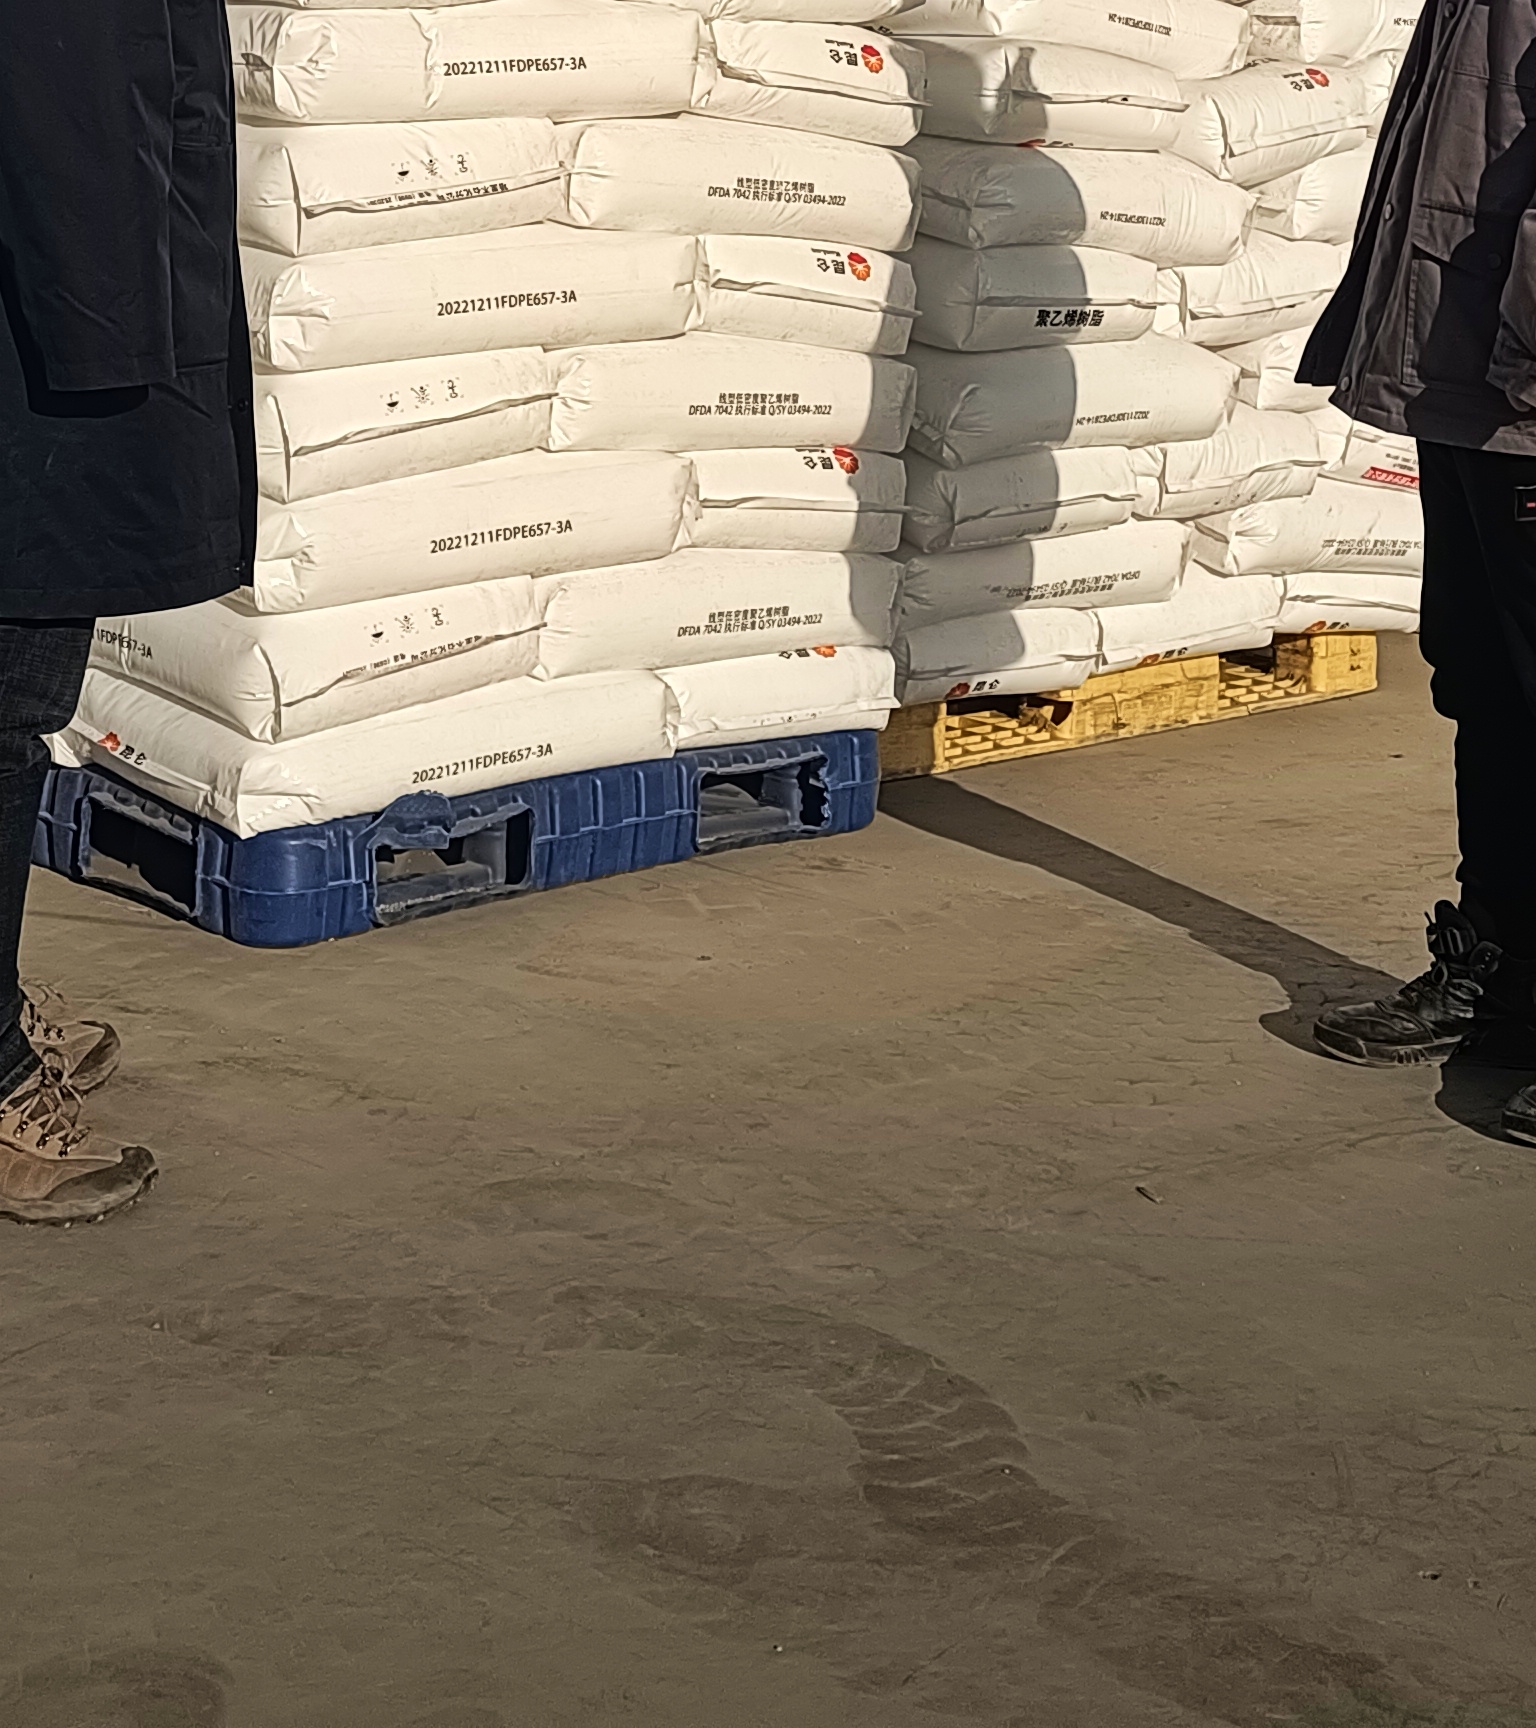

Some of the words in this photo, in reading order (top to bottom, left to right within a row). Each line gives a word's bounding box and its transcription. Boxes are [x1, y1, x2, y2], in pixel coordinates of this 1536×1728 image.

[444, 57, 587, 76] 20221211FDPE657-3A
[829, 49, 858, 66] 昆仑
[707, 186, 730, 198] DFDA
[733, 188, 750, 199] 7042
[752, 190, 783, 201] 执行标准
[784, 191, 802, 203] Q/SY
[803, 193, 846, 206] 03494-2022
[817, 258, 845, 274] 昆仑
[437, 290, 577, 316] 20221211FDPE657-3A
[1035, 309, 1104, 328] 聚乙烯树脂
[689, 405, 712, 416] DFDA
[713, 405, 733, 416] 7042
[734, 405, 767, 416] 执行标准
[768, 405, 786, 416] Q/SY
[787, 405, 832, 415] 03494-2022
[430, 519, 572, 553] 20221211FDPE657-3A
[678, 625, 701, 637] DFDA
[703, 623, 722, 635] 7042
[724, 620, 757, 633] 执行标准
[758, 618, 776, 631] Q/SY
[777, 613, 823, 628] 03494-2022
[119, 744, 147, 765] 昆仑
[412, 743, 552, 784] 20221211FDPE657-3A
